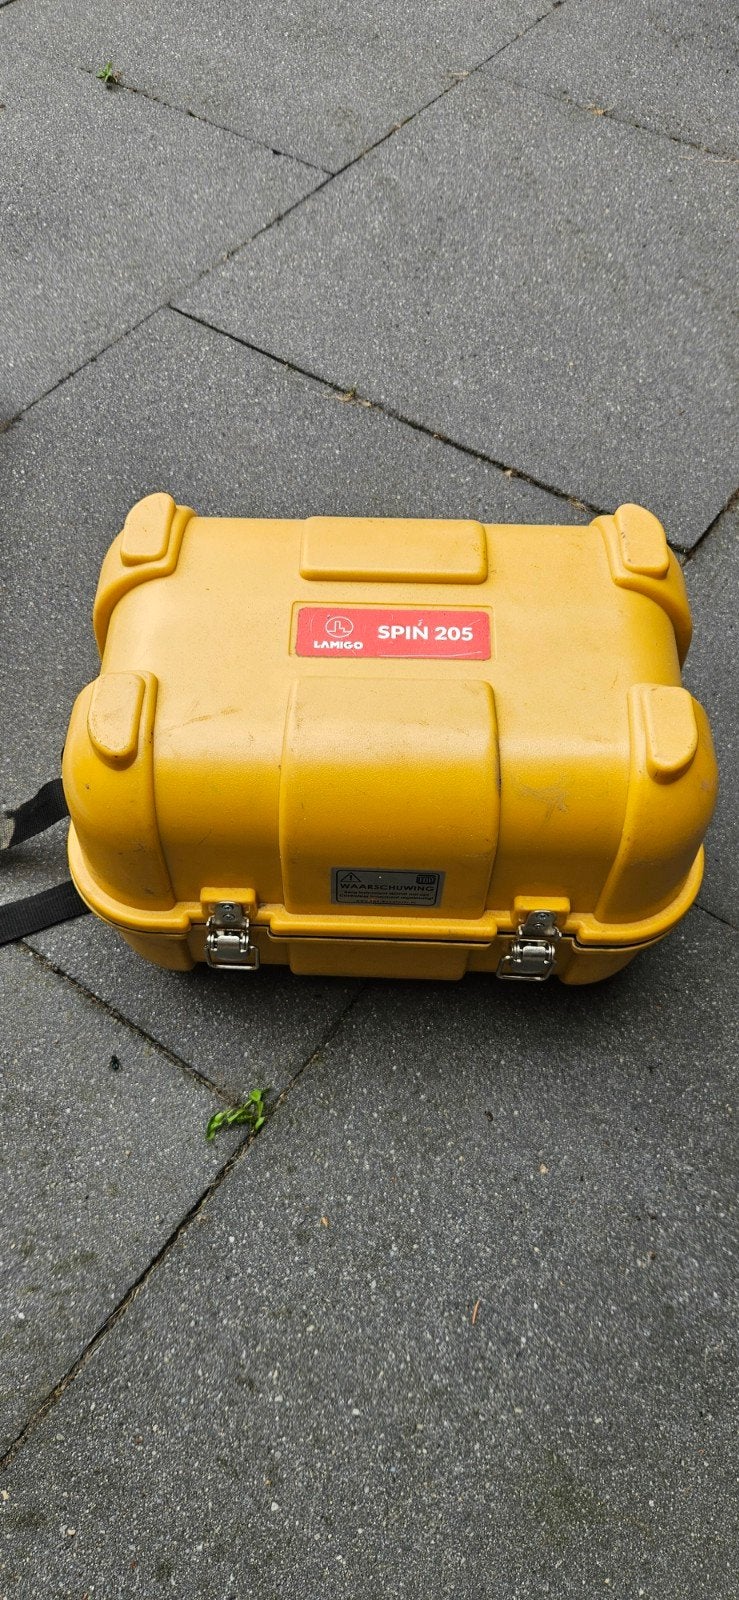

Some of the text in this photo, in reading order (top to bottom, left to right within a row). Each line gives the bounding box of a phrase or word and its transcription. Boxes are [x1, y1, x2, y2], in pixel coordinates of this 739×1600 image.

[377, 625, 474, 641] SPIN 205
[313, 639, 364, 650] LAMIGO
[339, 883, 435, 892] WAARSCHUWING
